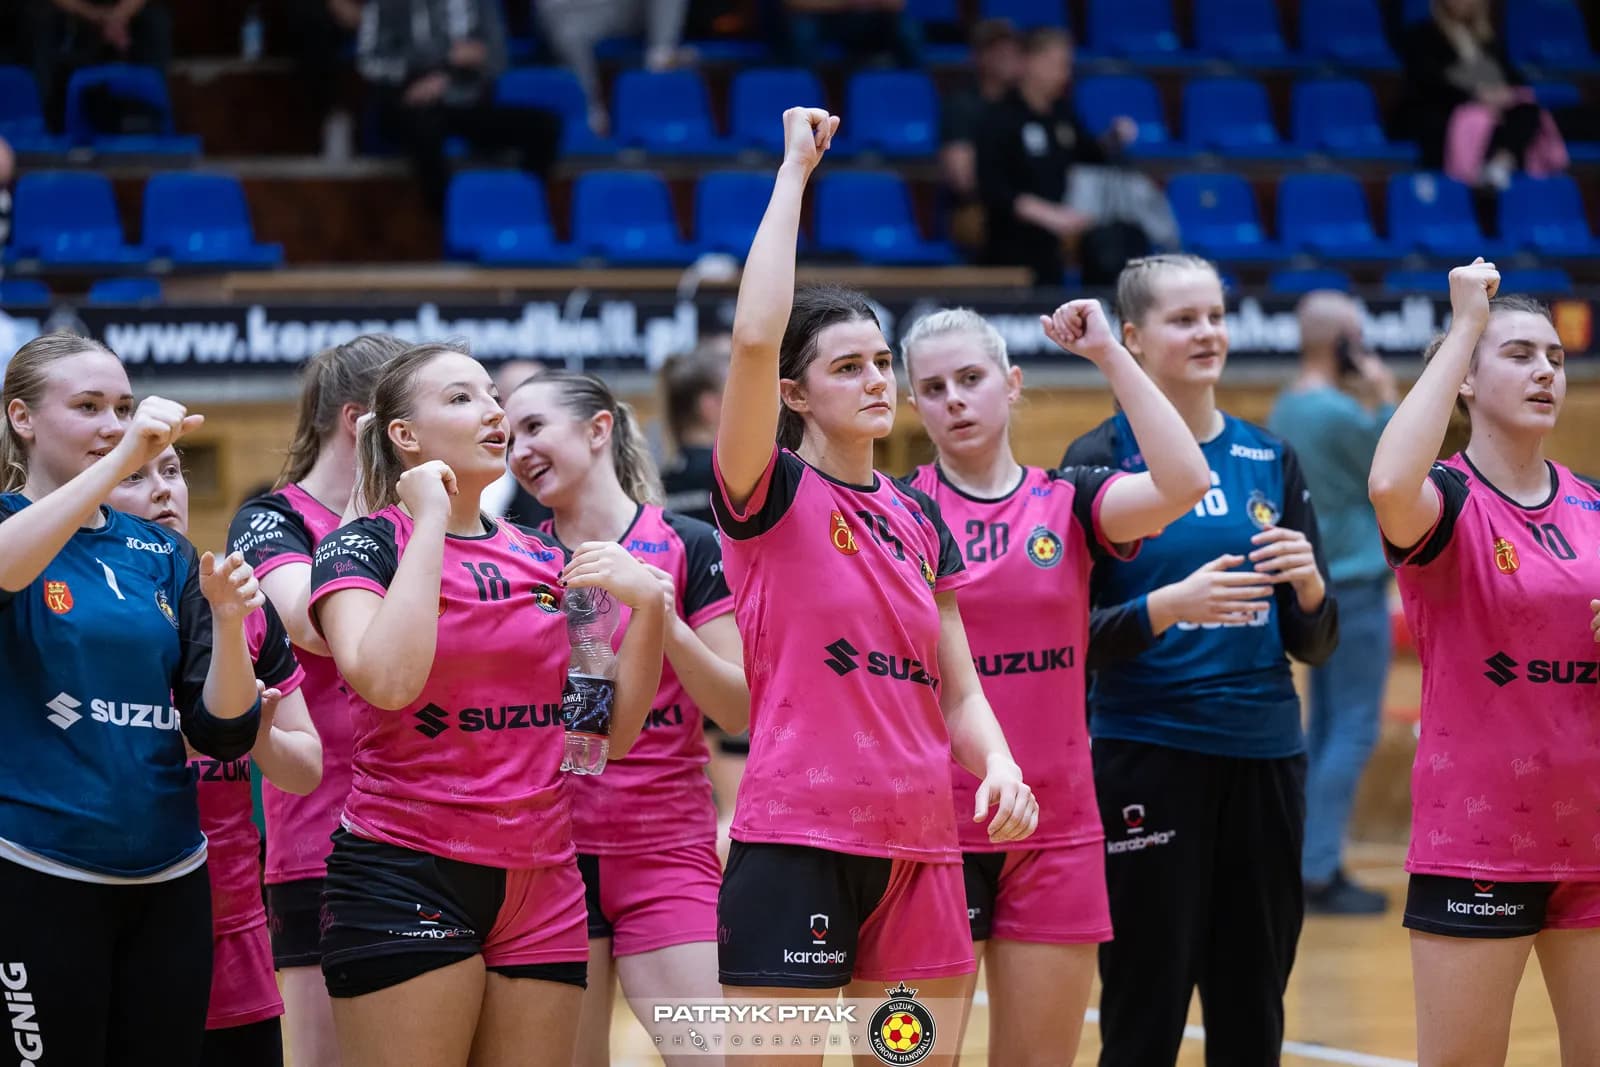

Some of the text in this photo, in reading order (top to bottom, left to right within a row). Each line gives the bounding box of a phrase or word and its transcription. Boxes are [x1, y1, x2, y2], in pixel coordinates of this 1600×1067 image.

[966, 520, 1009, 562] 20
[1526, 521, 1577, 560] 10
[95, 557, 126, 601] 1
[461, 561, 510, 602] 18
[47, 593, 69, 611] CK
[867, 651, 939, 692] SUZ
[972, 646, 1075, 677] UZUKI
[1527, 659, 1600, 685] SUZ
[91, 698, 180, 731] SUZU
[458, 703, 562, 733] SUZU
[1447, 899, 1517, 916] karabela
[784, 949, 844, 964] karabela
[0, 962, 43, 1067] GNiG
